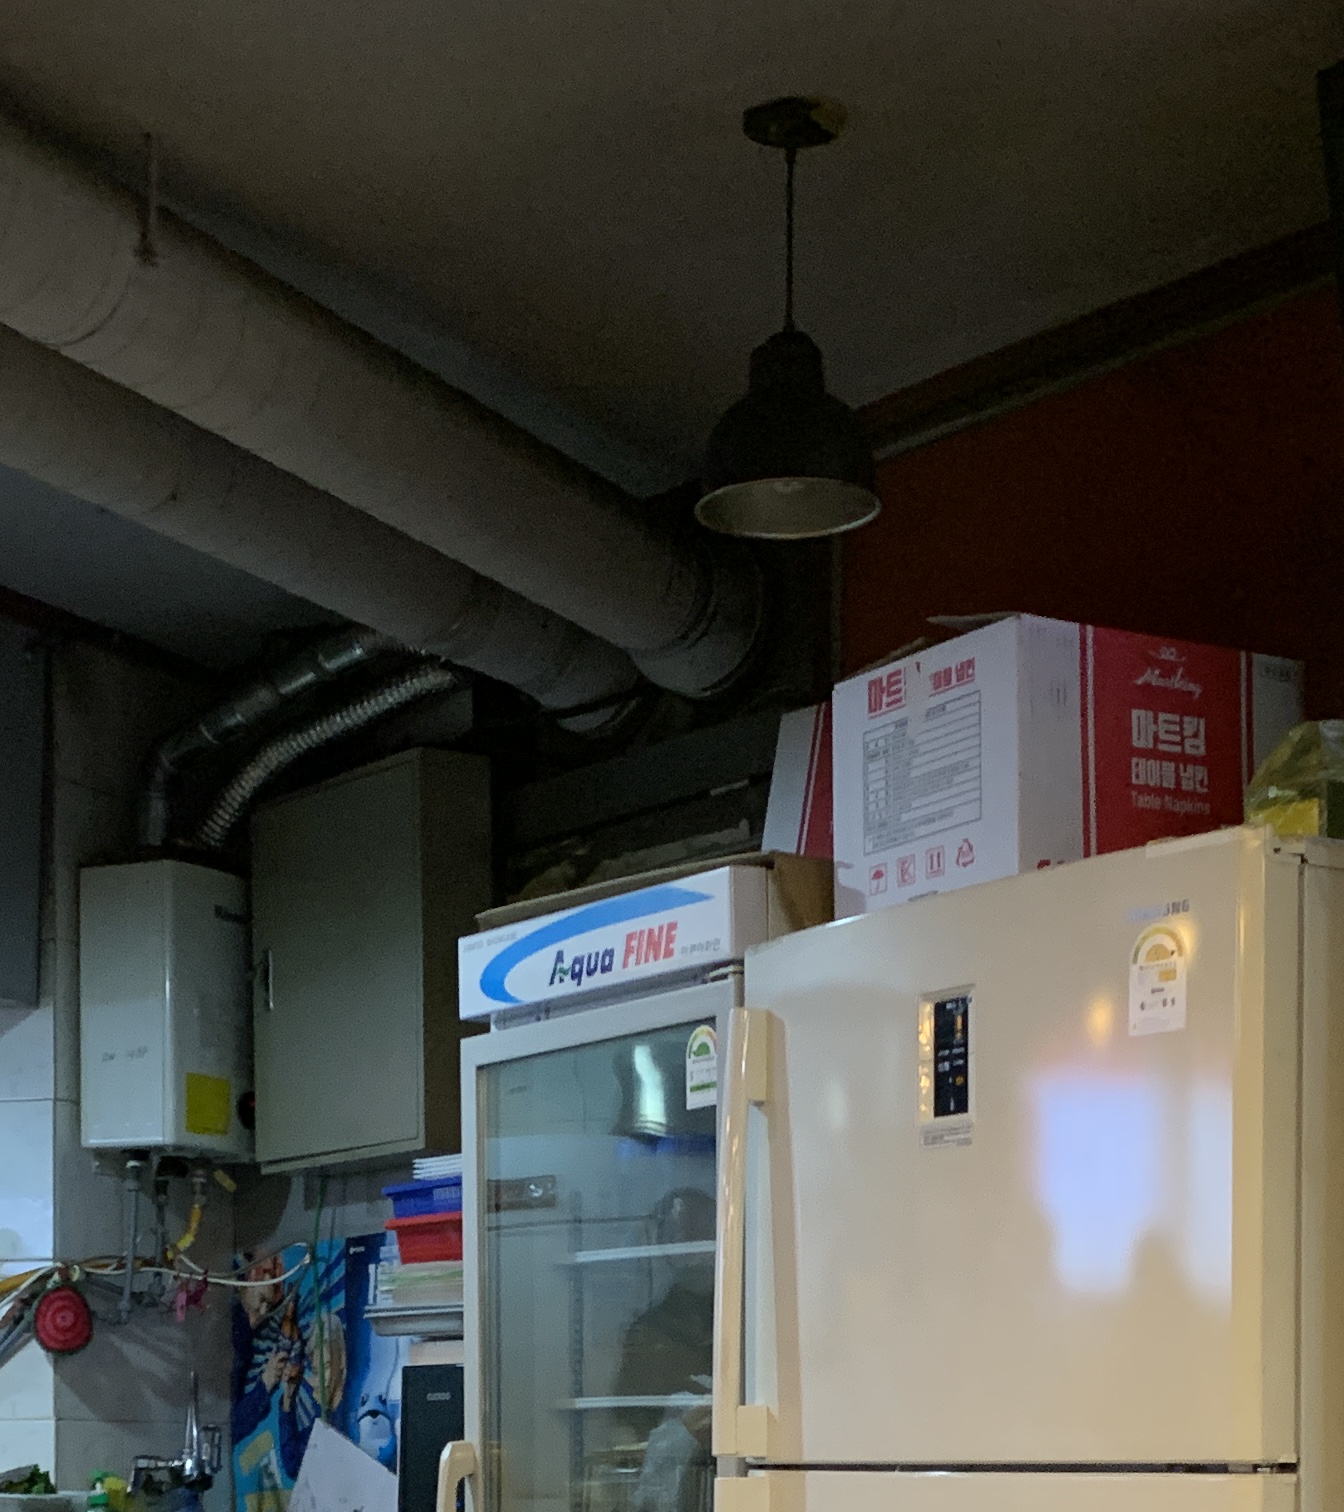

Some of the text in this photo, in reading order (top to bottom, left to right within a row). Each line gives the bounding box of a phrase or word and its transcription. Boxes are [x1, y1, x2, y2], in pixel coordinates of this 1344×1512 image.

[1130, 708, 1207, 757] 마트킹
[1130, 756, 1176, 790] 테이블
[548, 946, 615, 988] Aqua
[621, 920, 679, 970] FINE
